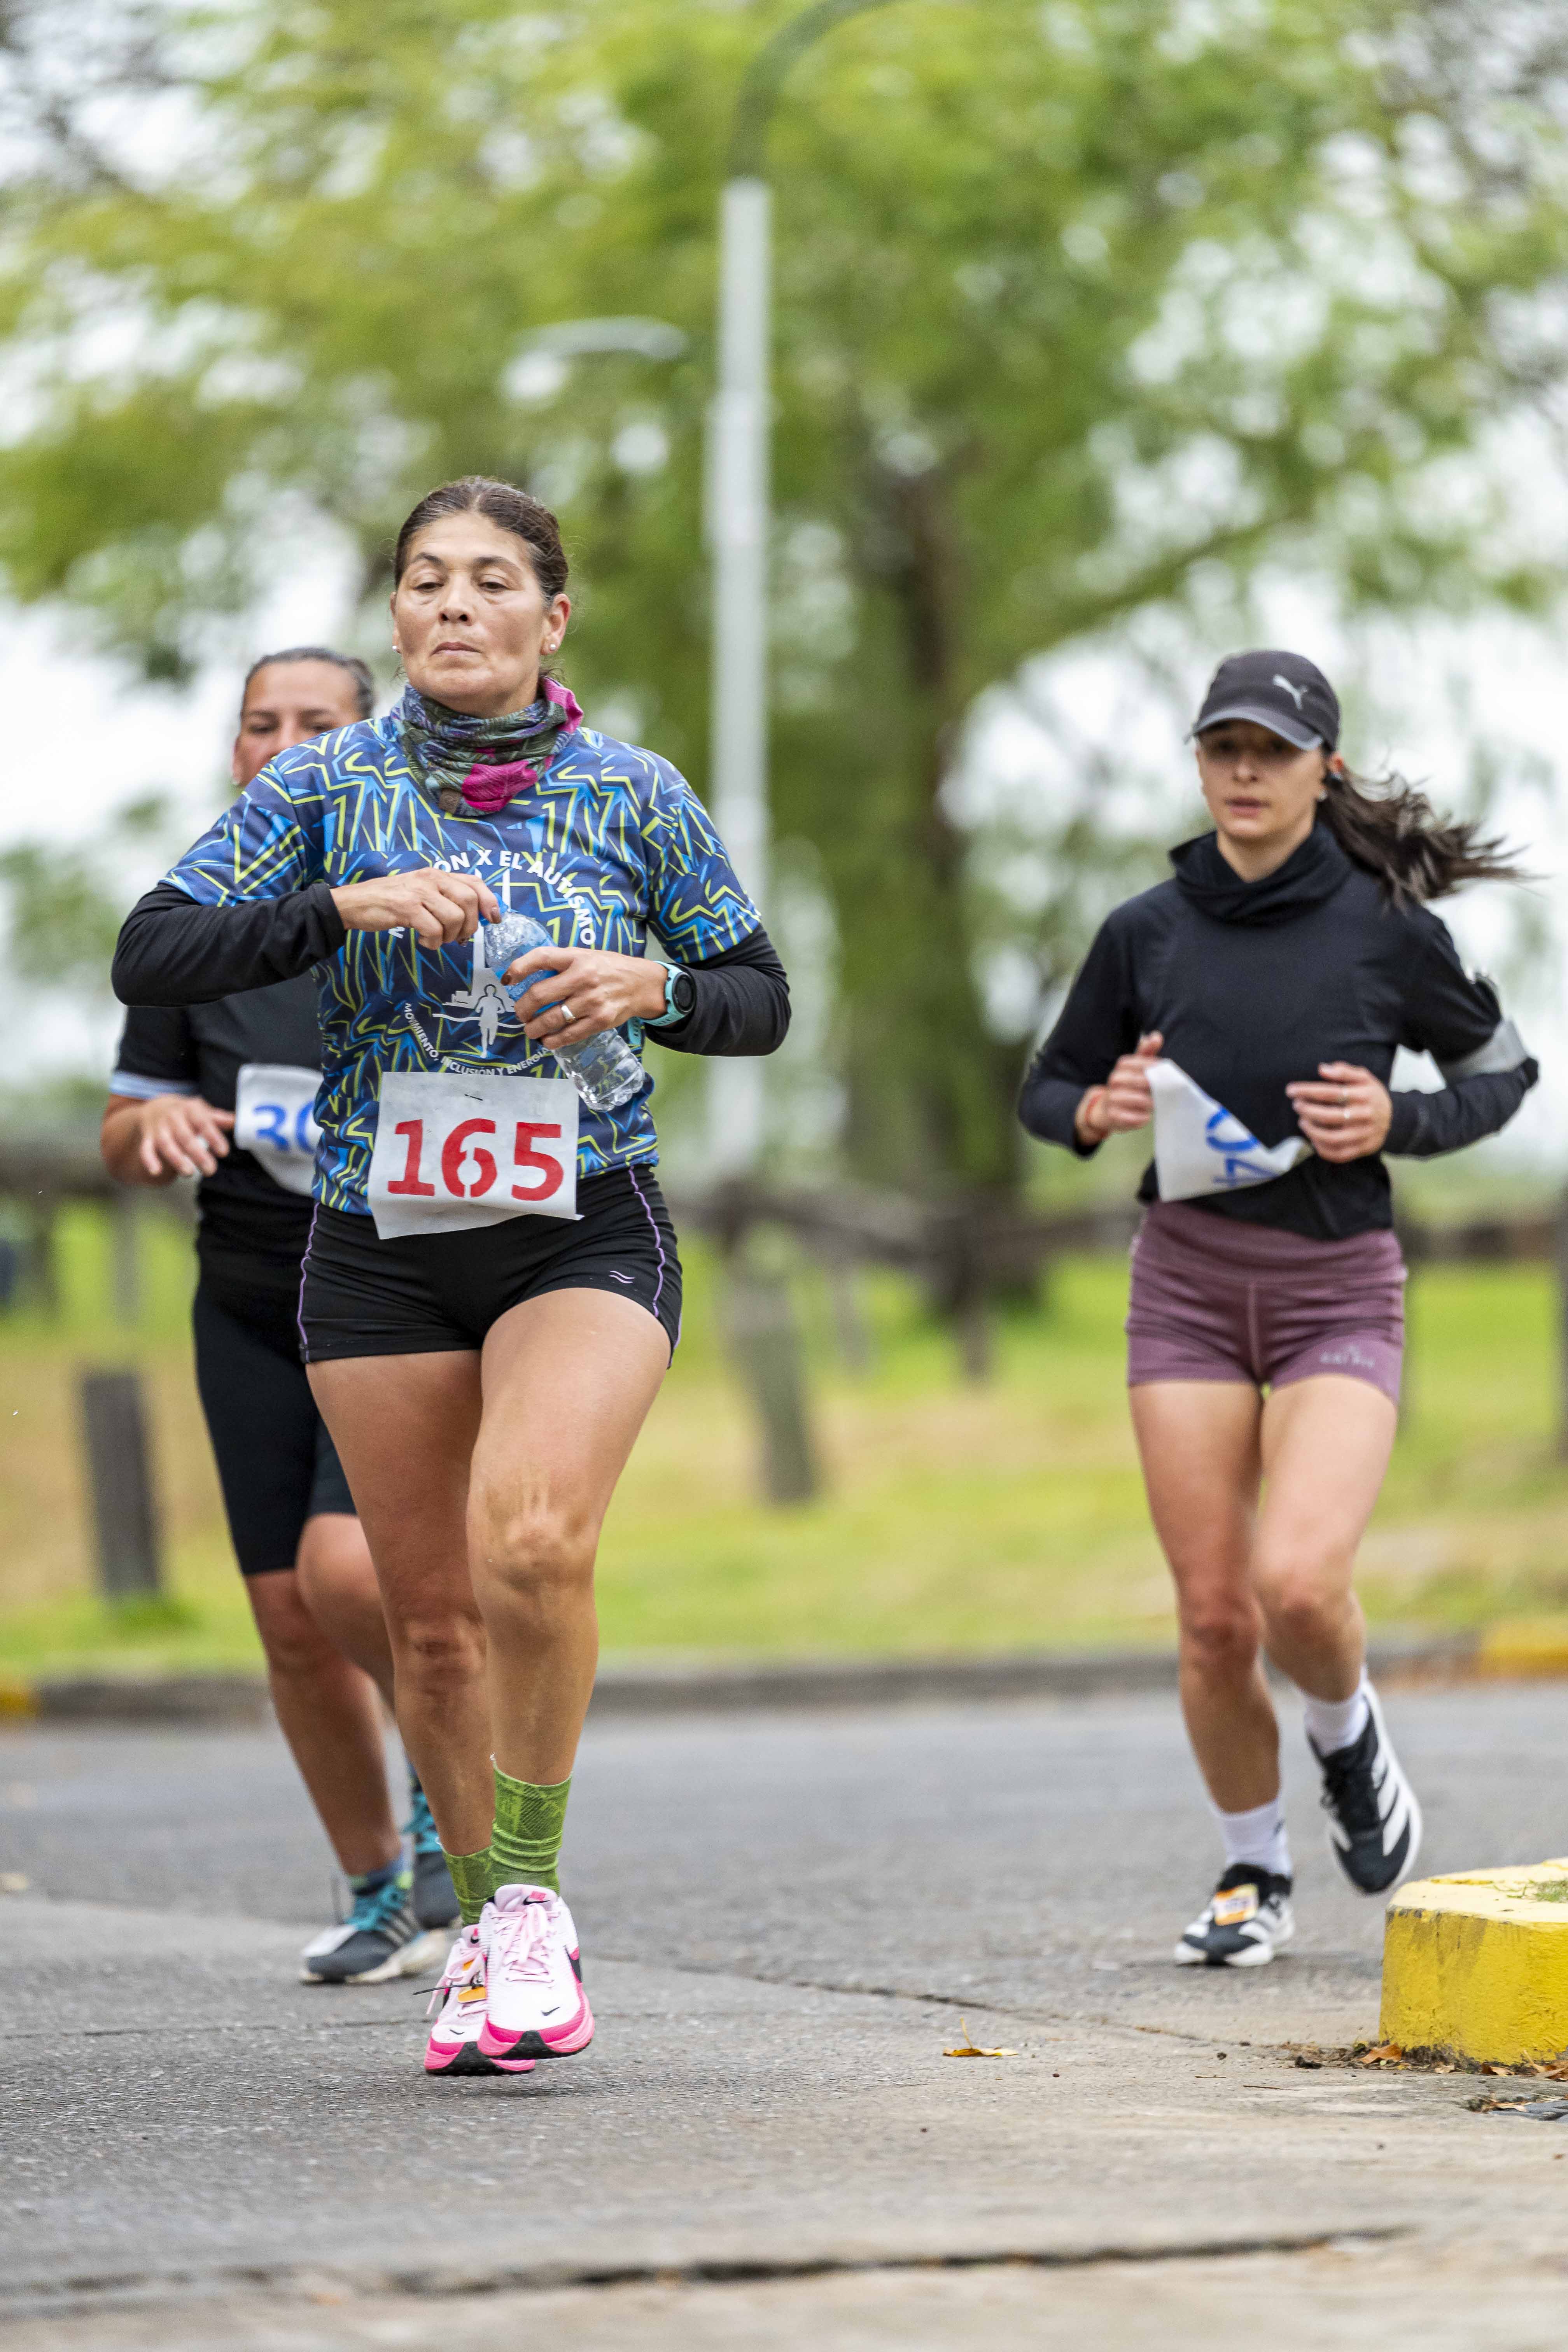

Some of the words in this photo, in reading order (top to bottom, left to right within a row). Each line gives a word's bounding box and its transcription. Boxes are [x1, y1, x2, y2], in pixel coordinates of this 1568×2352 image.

[476, 849, 493, 866] X
[499, 850, 523, 870] EL
[526, 860, 596, 945] AUTISMO
[496, 1067, 505, 1076] Y
[387, 1118, 564, 1201] 165
